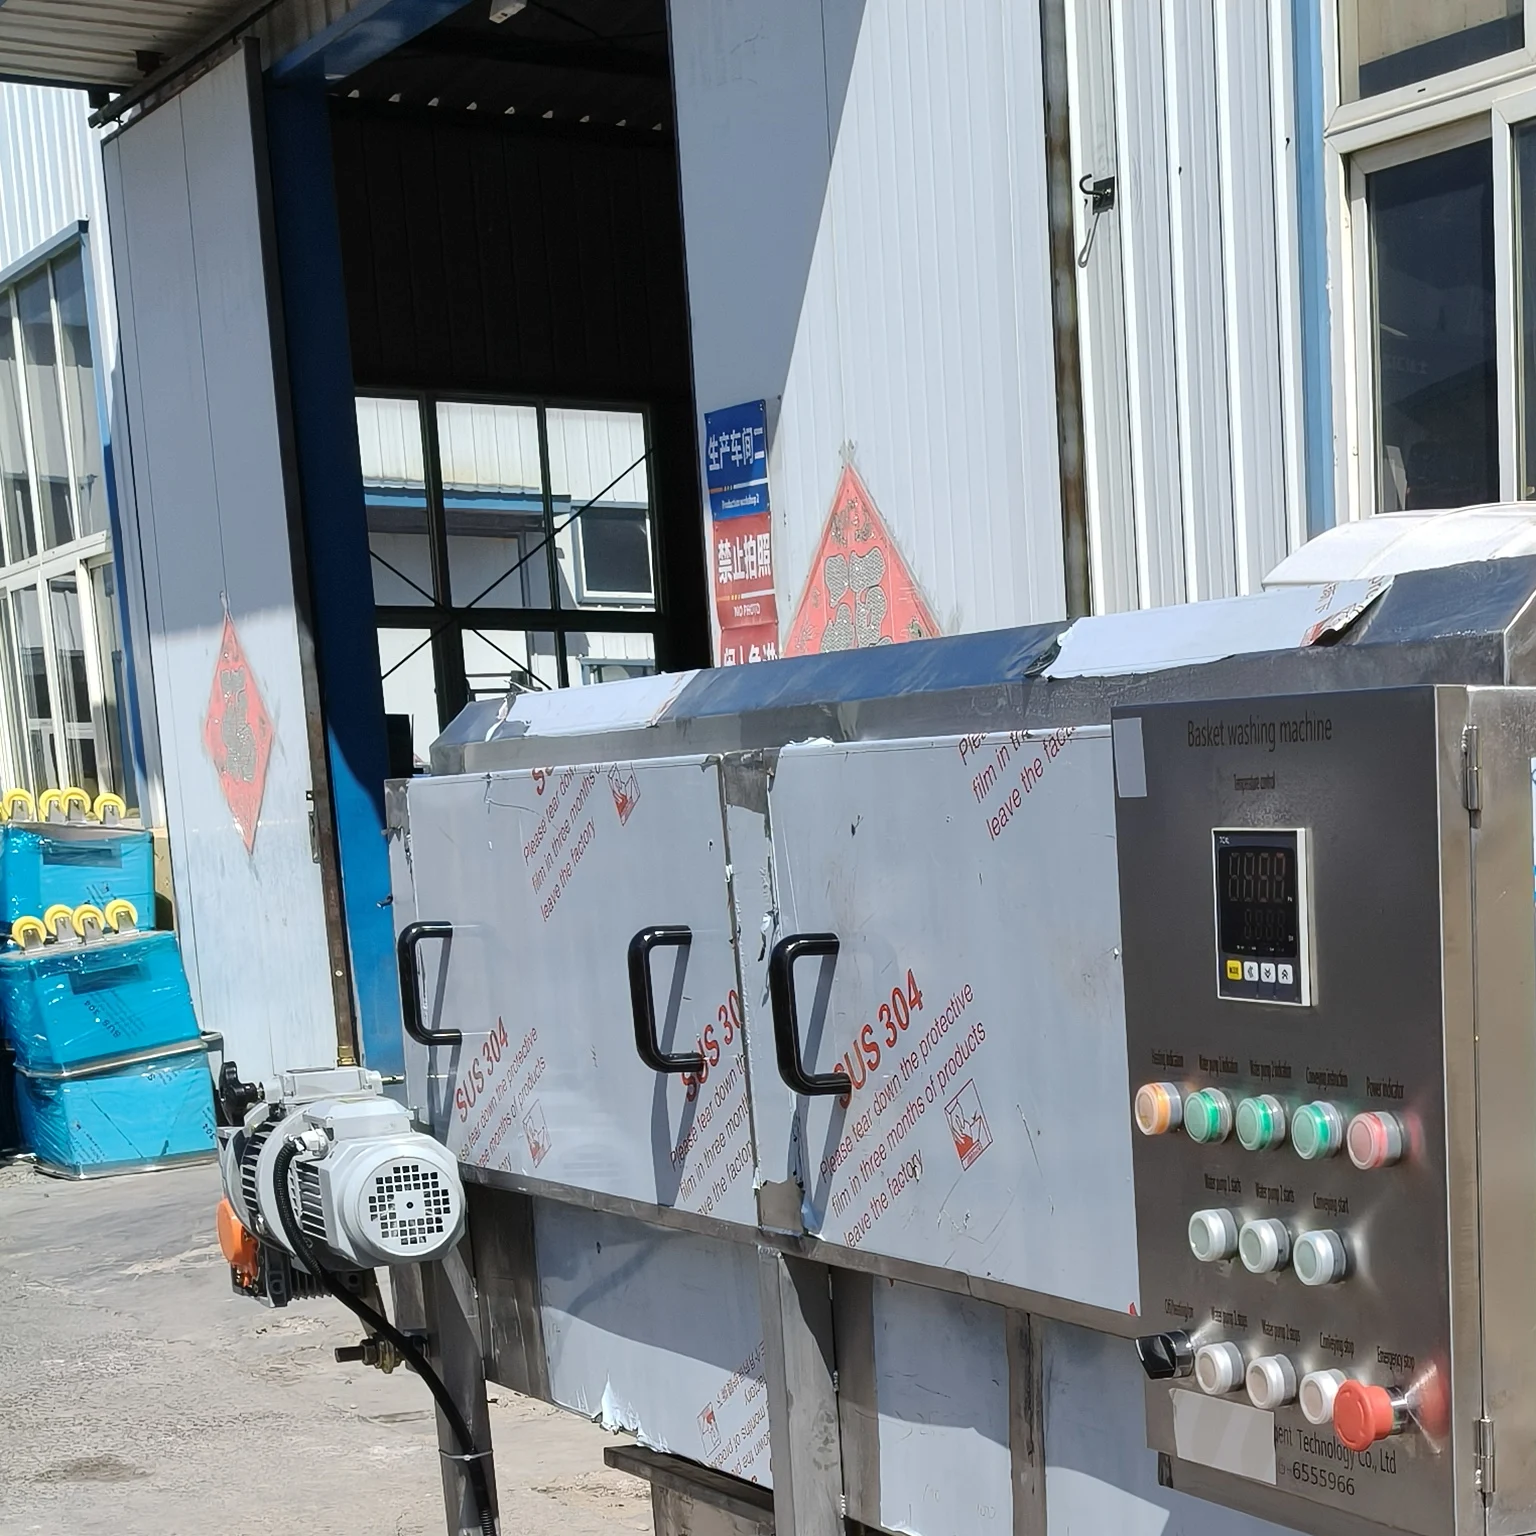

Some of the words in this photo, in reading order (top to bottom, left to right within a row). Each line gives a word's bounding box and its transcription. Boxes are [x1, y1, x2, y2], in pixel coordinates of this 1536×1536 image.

[708, 427, 764, 471] 生产车间二
[718, 532, 771, 584] 禁止拍照
[734, 603, 744, 617] NO
[744, 602, 761, 616] PHOTO
[1188, 718, 1225, 747] Basket
[1228, 714, 1276, 752] washing
[1280, 709, 1332, 743] machine
[972, 764, 997, 804] film
[995, 745, 1010, 772] in
[986, 788, 1022, 841] leave
[1020, 757, 1044, 793] the
[524, 819, 547, 866] Please
[545, 790, 561, 823] tear
[532, 866, 547, 894] film
[544, 853, 554, 869] in
[551, 819, 571, 858] three
[570, 771, 596, 825] months
[540, 884, 561, 922] leave
[558, 862, 573, 889] the
[570, 816, 596, 867] factory
[718, 990, 742, 1045] 30
[834, 1024, 881, 1109] SUS
[878, 968, 923, 1048] 304
[455, 1058, 484, 1123] SUS
[482, 1015, 508, 1076] 304
[467, 1121, 482, 1148] tear
[480, 1093, 498, 1128] down
[495, 1079, 508, 1101] the
[506, 1027, 539, 1088] protective
[489, 1111, 512, 1155] months
[518, 1055, 547, 1111] products
[820, 1135, 853, 1183] Please
[852, 1107, 874, 1149] tear
[873, 1075, 902, 1117] down
[900, 1051, 920, 1083] the
[918, 984, 974, 1059] protective
[669, 1125, 698, 1172] Please
[697, 1100, 713, 1133] tear
[713, 1068, 738, 1108] down
[831, 1187, 852, 1218] film
[849, 1174, 862, 1199] in
[860, 1143, 886, 1184] three
[886, 1099, 925, 1152] months
[924, 1075, 937, 1105] of
[937, 1021, 986, 1096] products
[679, 1174, 697, 1202] film
[694, 1161, 706, 1183] in
[703, 1133, 726, 1170] three
[713, 1176, 728, 1206] the
[843, 1213, 872, 1249] leave
[869, 1192, 888, 1223] the
[887, 1149, 923, 1204] factory
[1377, 1345, 1403, 1373] Emergency
[1403, 1352, 1415, 1373] stop
[1292, 1461, 1355, 1496] 6555966
[1297, 1429, 1355, 1471] Technology
[1380, 1449, 1397, 1475] Ltd
